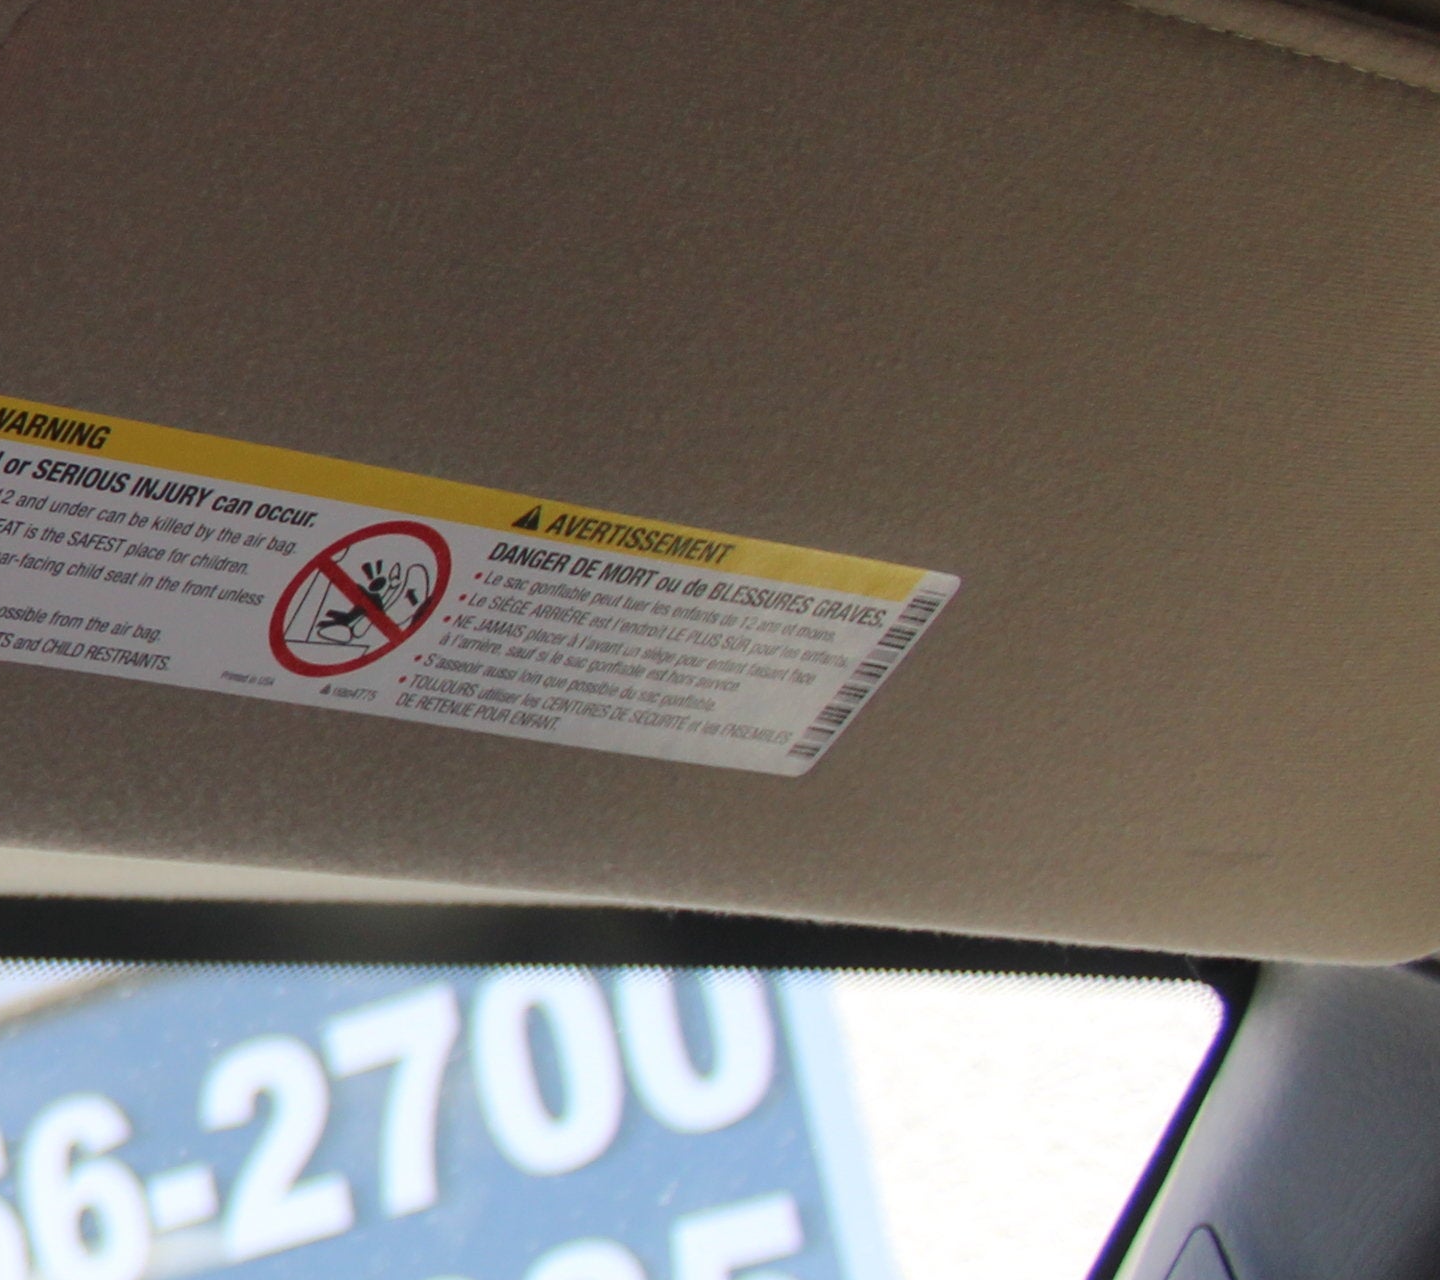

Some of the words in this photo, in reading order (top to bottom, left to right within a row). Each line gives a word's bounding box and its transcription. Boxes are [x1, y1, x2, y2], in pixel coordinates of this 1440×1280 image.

[2, 457, 33, 476] or
[31, 458, 132, 494] SERIOUS
[129, 476, 215, 508] INJURY
[211, 495, 254, 516] can
[254, 503, 319, 528] occur.
[14, 494, 50, 511] and
[48, 500, 97, 519] under
[95, 508, 128, 525] can
[127, 511, 150, 529] be
[150, 515, 196, 537] killed
[193, 523, 216, 542] by
[215, 527, 243, 545] the
[242, 532, 268, 548] air
[265, 535, 297, 557] bag.
[543, 517, 730, 564] AVERTISSEMENT
[22, 523, 40, 540] is
[39, 526, 66, 544] the
[66, 530, 128, 553] SAFEST
[122, 542, 167, 561] place
[166, 547, 191, 565] for
[189, 552, 249, 576] children.
[65, 561, 106, 580] child
[103, 569, 139, 586] seat
[137, 572, 155, 589] in
[154, 575, 181, 593] the
[180, 579, 219, 599] front
[216, 588, 265, 607] unless
[487, 541, 572, 574] DANGER
[568, 556, 603, 579] DE
[597, 562, 660, 588] MORT
[654, 576, 683, 594] ou
[681, 578, 709, 598] de
[706, 581, 816, 615] BLESSURES
[811, 599, 888, 629] GRAVES.
[502, 576, 530, 591] sac
[527, 581, 592, 603] gonflable
[588, 592, 624, 608] peut
[621, 595, 652, 612] tuer
[649, 600, 672, 617] les
[48, 610, 85, 630] from
[84, 616, 111, 634] the
[109, 621, 133, 637] air
[131, 623, 162, 644] bag.
[487, 595, 533, 616] SIÈGE
[528, 603, 592, 626] ARRIÈRE
[472, 618, 528, 638] JAMAIS
[522, 627, 569, 646] placer
[12, 637, 44, 652] and
[40, 638, 86, 658] CHILD
[83, 644, 171, 671] RESTRAINTS.
[408, 673, 480, 698] TOUJOURS
[414, 695, 477, 718] RETENUE
[472, 704, 512, 723] POUR
[508, 710, 562, 731] ENFANT.
